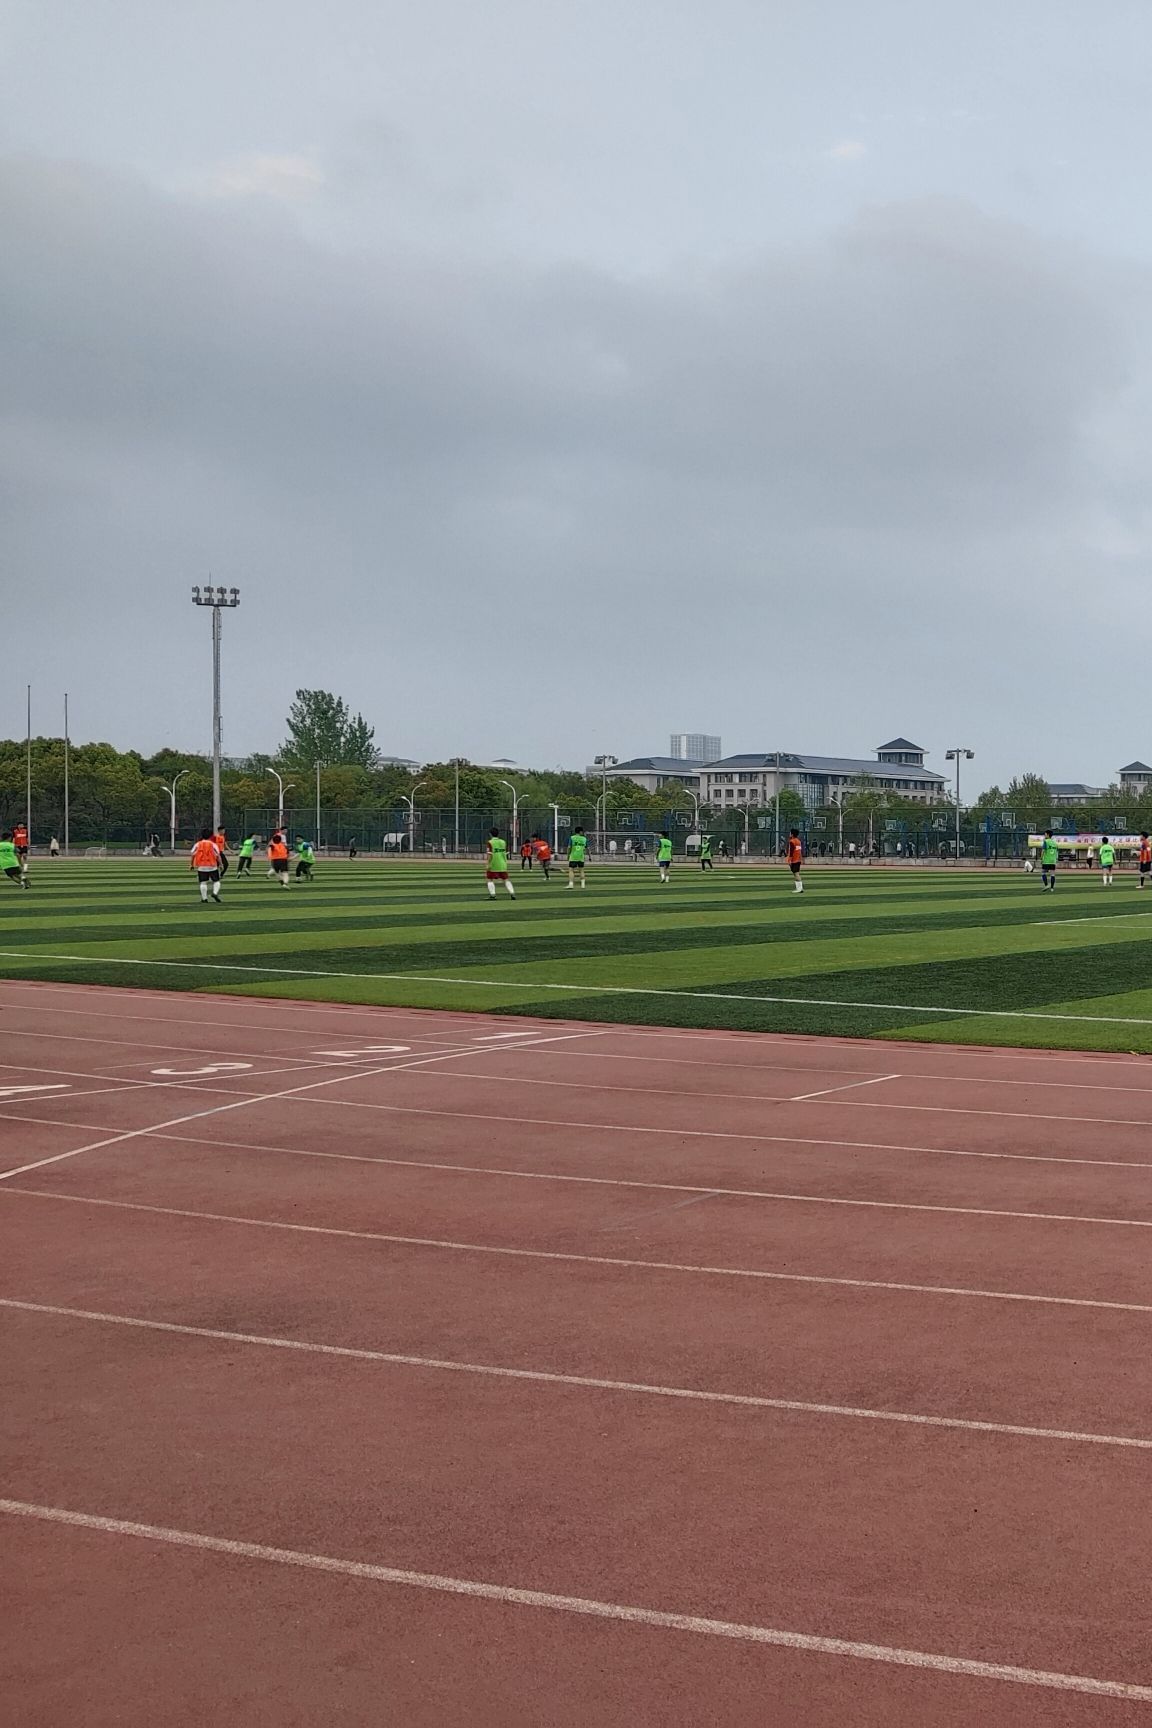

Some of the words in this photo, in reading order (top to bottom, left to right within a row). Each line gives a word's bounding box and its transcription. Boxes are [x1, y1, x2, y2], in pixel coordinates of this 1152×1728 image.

[472, 1031, 542, 1041] 1
[311, 1045, 412, 1057] 2
[150, 1062, 253, 1075] 3
